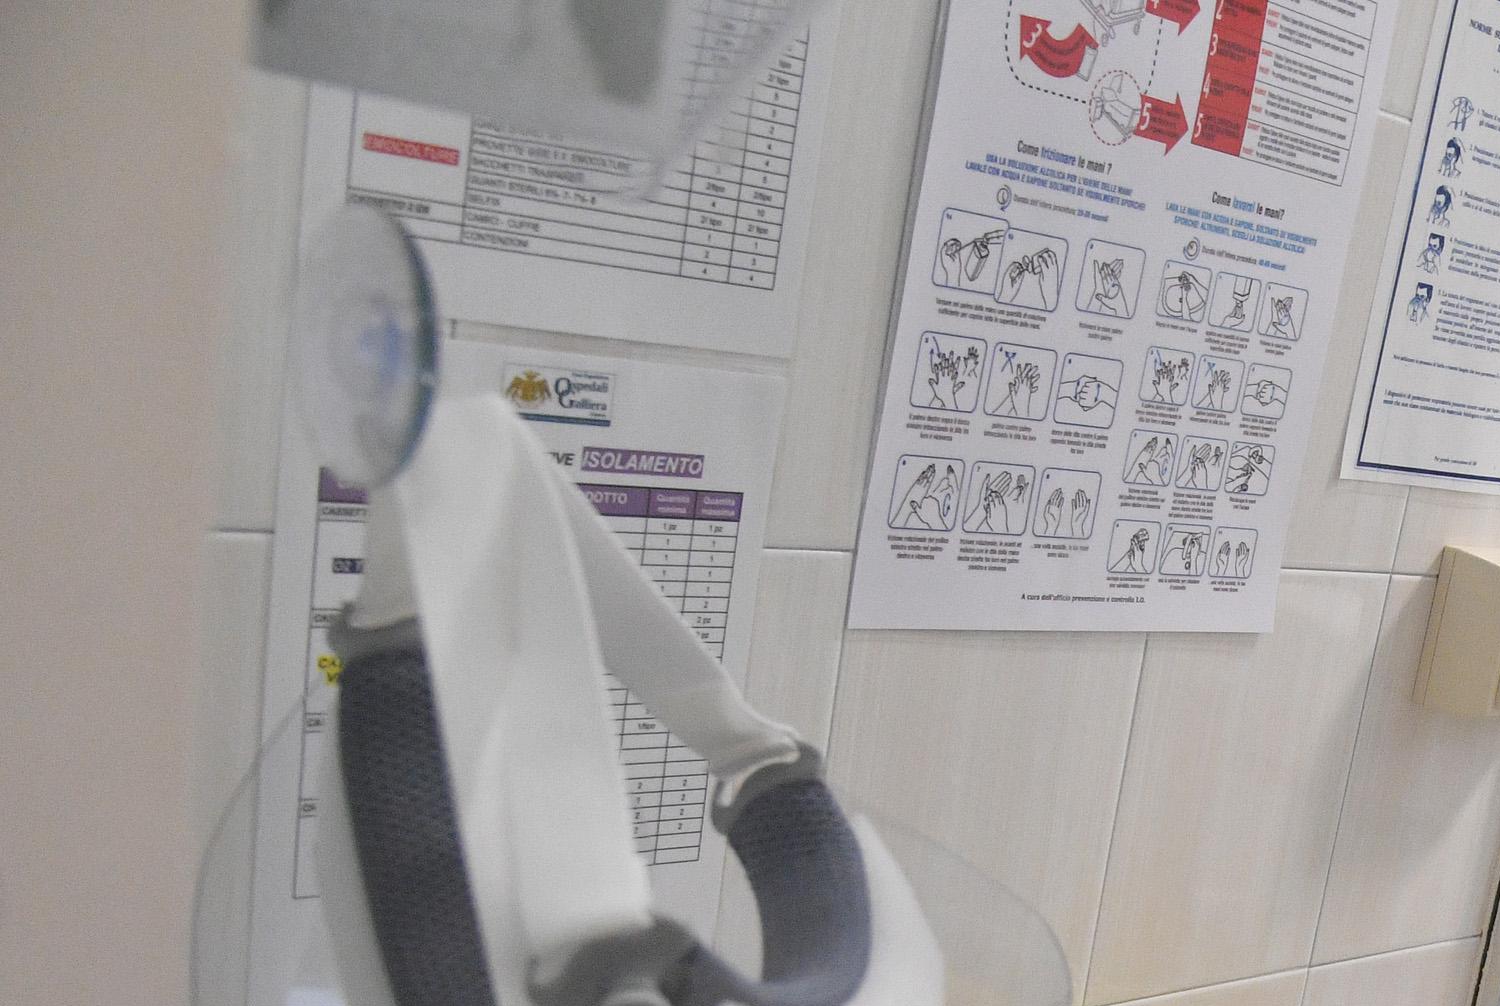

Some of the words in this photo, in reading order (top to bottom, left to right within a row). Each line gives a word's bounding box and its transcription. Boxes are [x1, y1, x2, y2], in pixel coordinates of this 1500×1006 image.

[1140, 103, 1152, 131] 5
[1017, 140, 1040, 157] Come
[1211, 191, 1232, 207] Come
[554, 377, 609, 398] Ospedali
[582, 450, 703, 476] ISOLAMENTO
